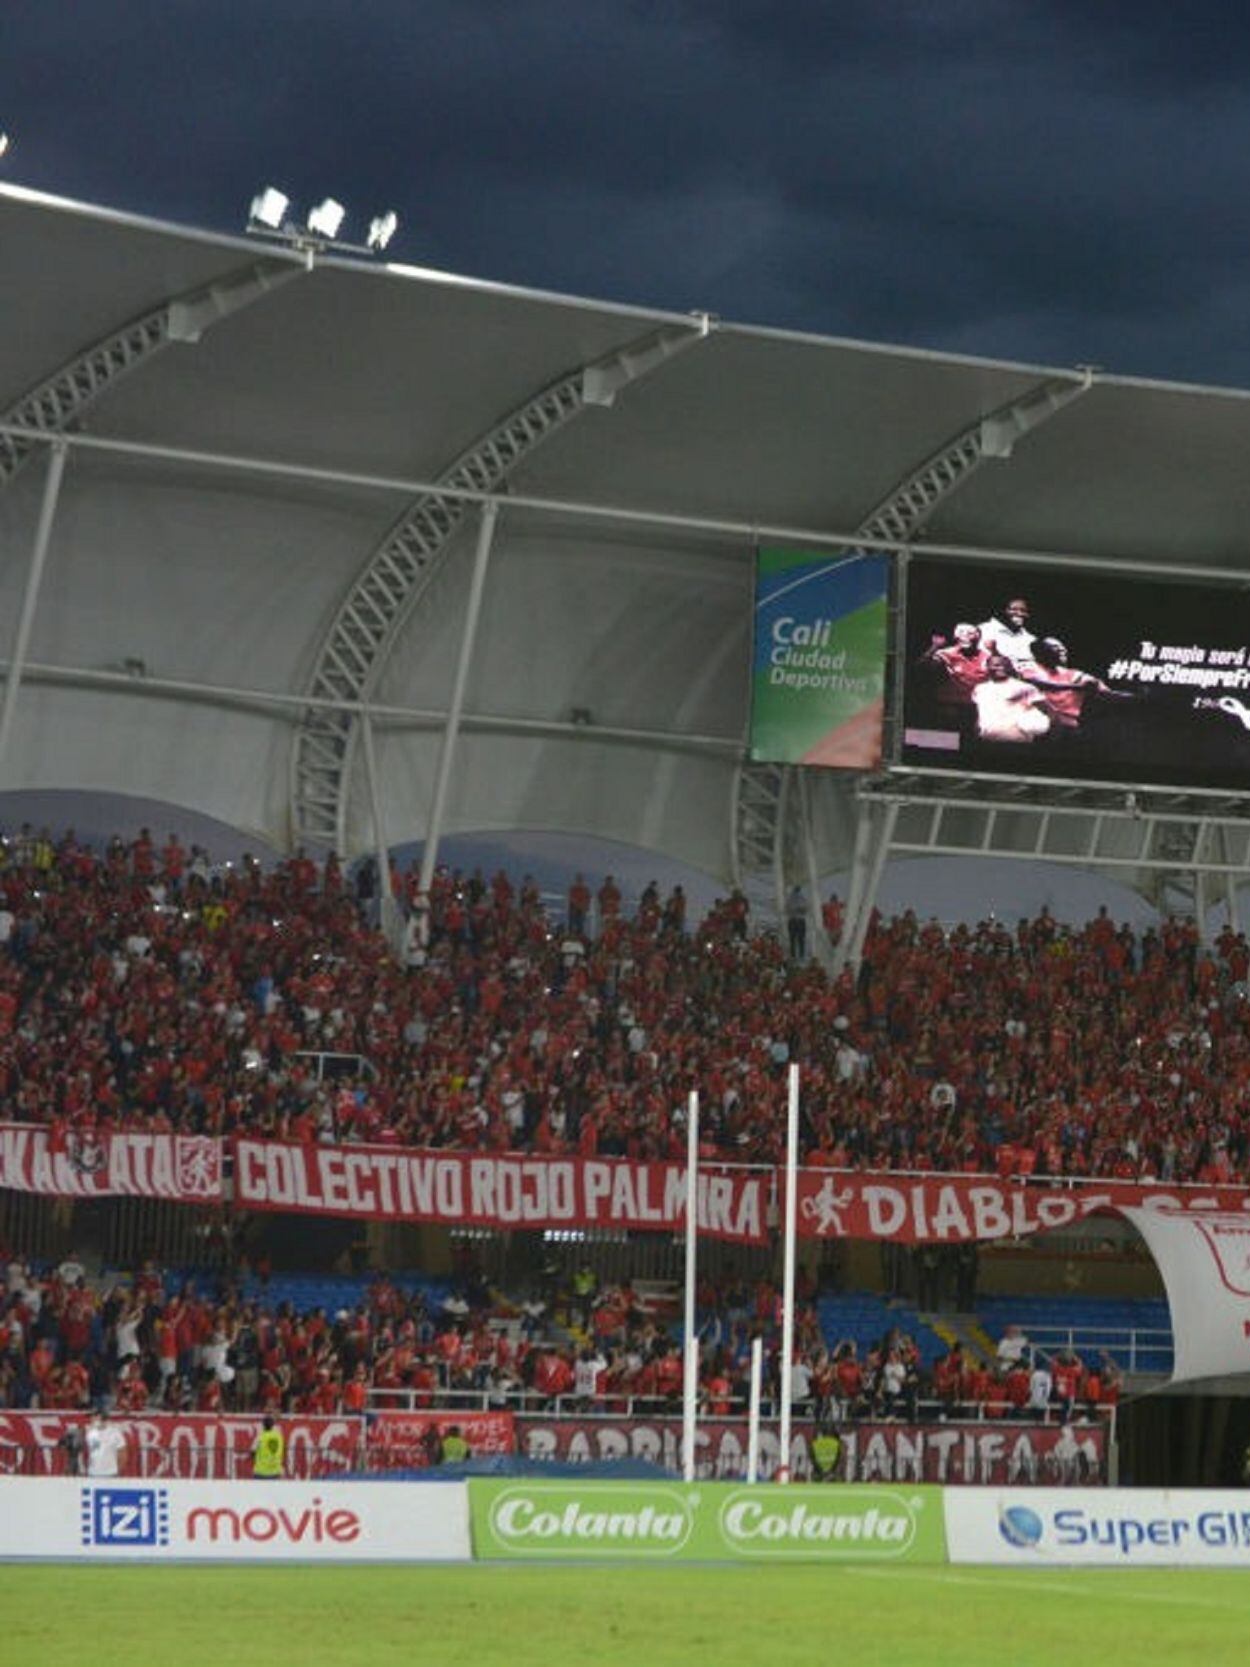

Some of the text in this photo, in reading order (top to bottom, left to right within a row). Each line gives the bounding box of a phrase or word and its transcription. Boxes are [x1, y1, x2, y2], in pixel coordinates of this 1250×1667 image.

[772, 617, 831, 648] Cali
[770, 646, 846, 669] Ciudad
[769, 666, 866, 691] Deportiva
[237, 1140, 760, 1237] COLECTIVO ROJO PALMIRA
[861, 1430, 1037, 1485] ANTIFA
[99, 1496, 361, 1543] izi movie
[496, 1499, 685, 1540] Colanta
[725, 1500, 909, 1541] Colanta
